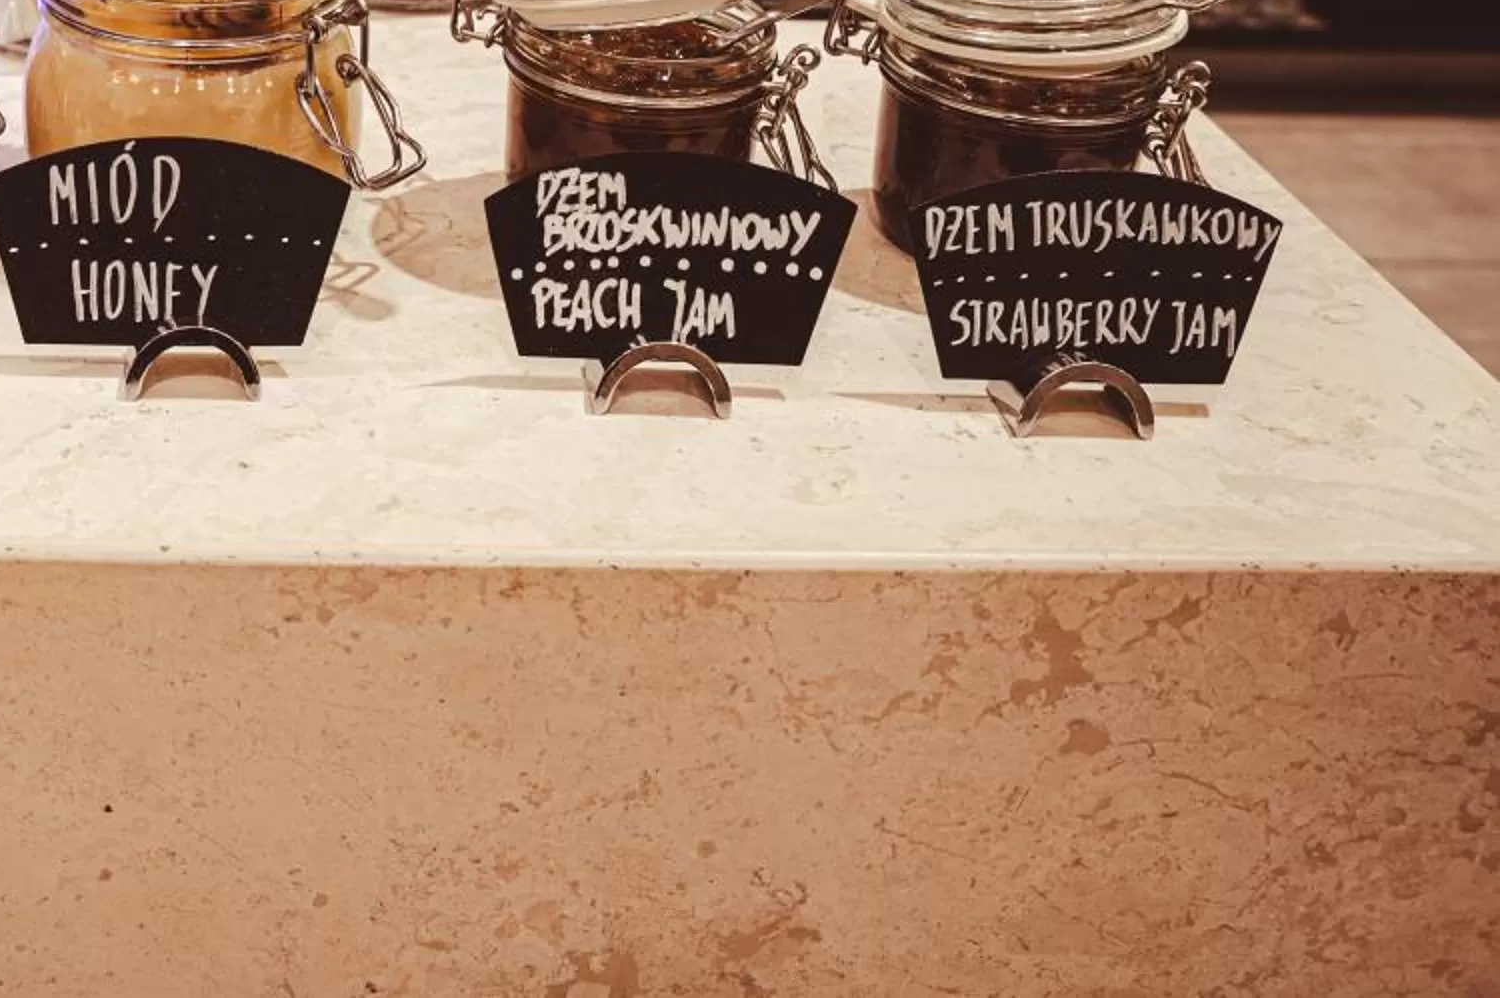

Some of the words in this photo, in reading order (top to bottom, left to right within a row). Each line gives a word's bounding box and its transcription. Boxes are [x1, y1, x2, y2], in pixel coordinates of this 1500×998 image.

[48, 140, 181, 233] MIÓD
[1025, 199, 1282, 262] TRUSKAWKOWY
[72, 259, 218, 326] HONEY
[531, 277, 641, 333] PEACH
[663, 278, 736, 340] JAM
[948, 296, 1161, 349] STRAWBERRY
[1168, 300, 1238, 358] JAM
